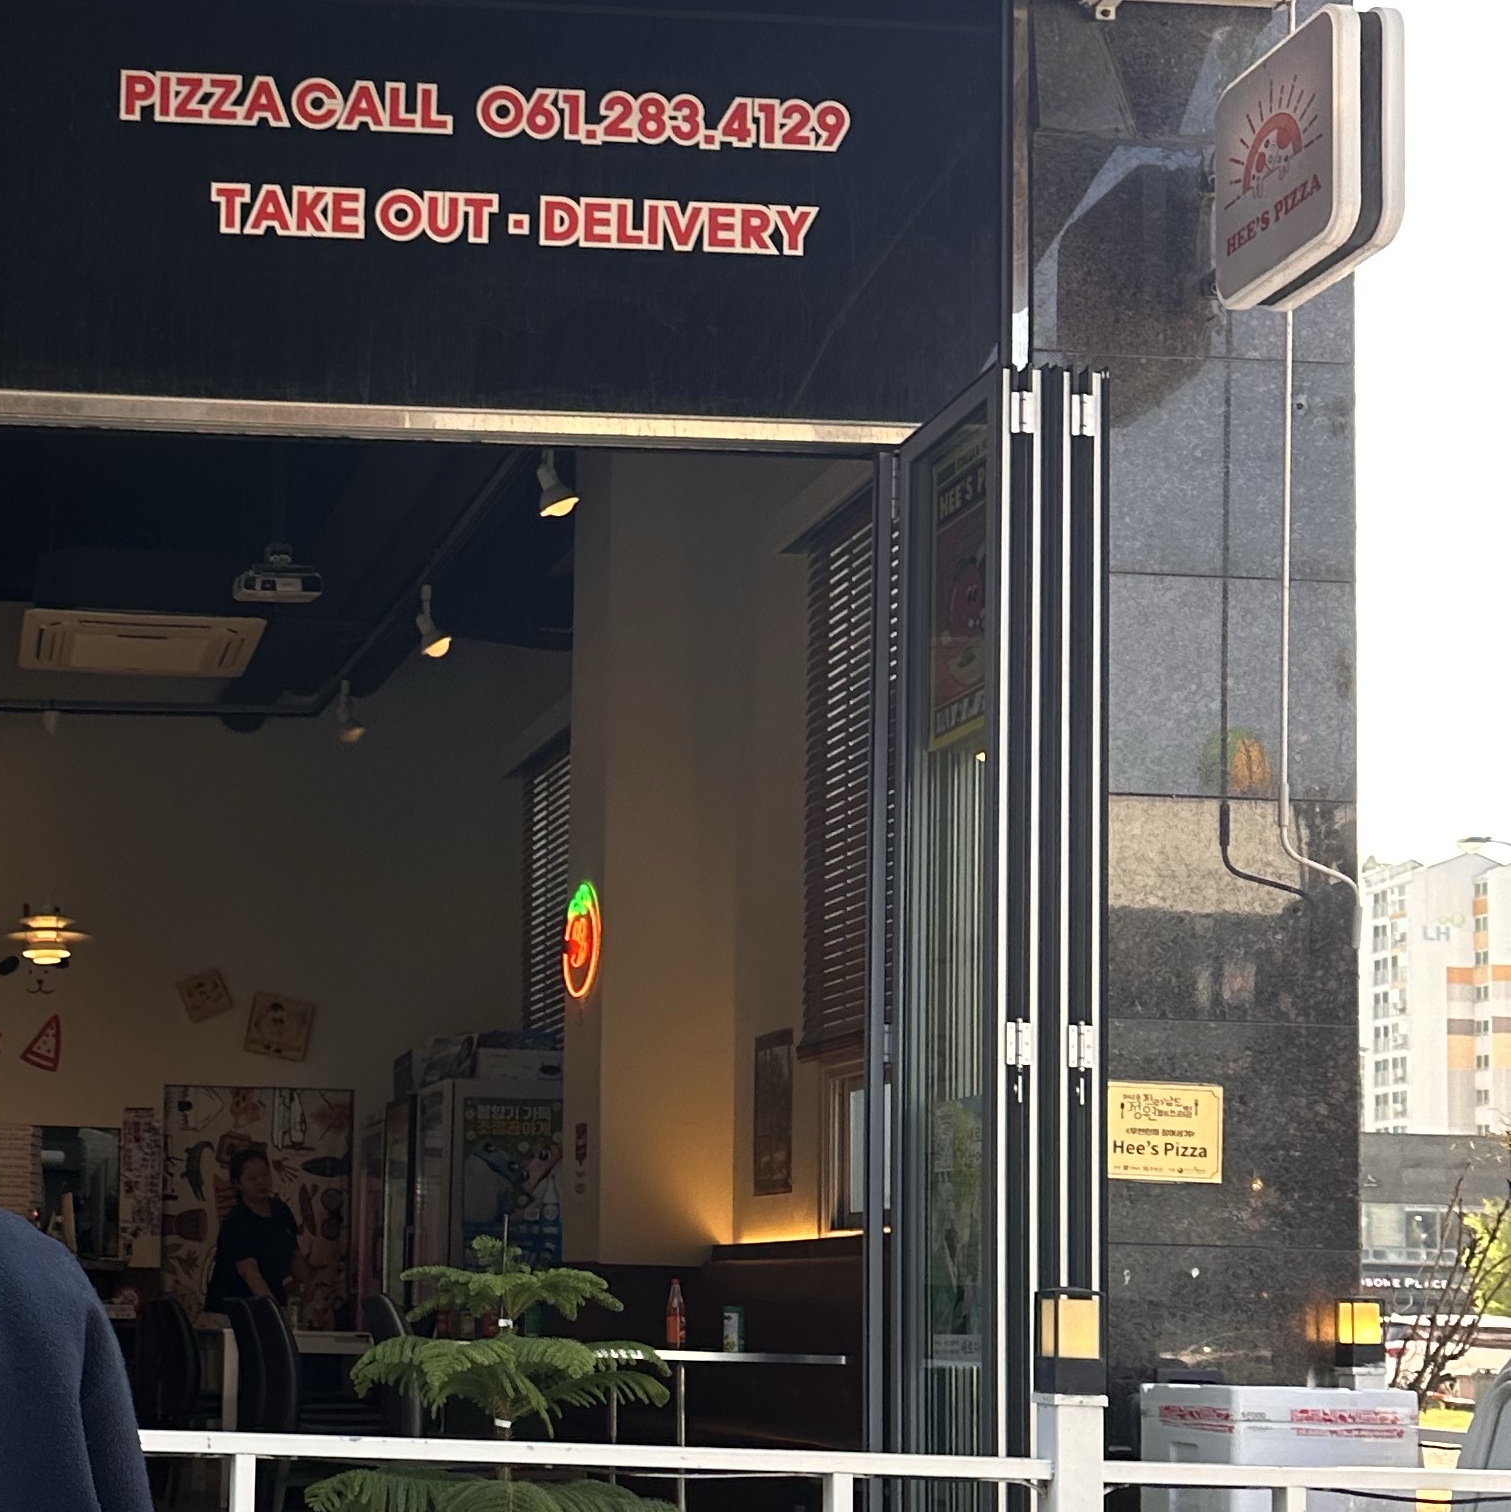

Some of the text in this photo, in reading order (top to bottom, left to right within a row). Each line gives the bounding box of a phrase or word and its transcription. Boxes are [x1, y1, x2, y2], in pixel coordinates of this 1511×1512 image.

[120, 69, 851, 152] PIZZA CALL 061.283.4129
[211, 182, 819, 256] TAKE OUT DELIVERY
[1226, 174, 1322, 257] HEE'S PIZZA
[939, 474, 974, 520] HEE'S
[1422, 925, 1451, 942] LH
[1113, 1139, 1207, 1158] Hee's Pizza
